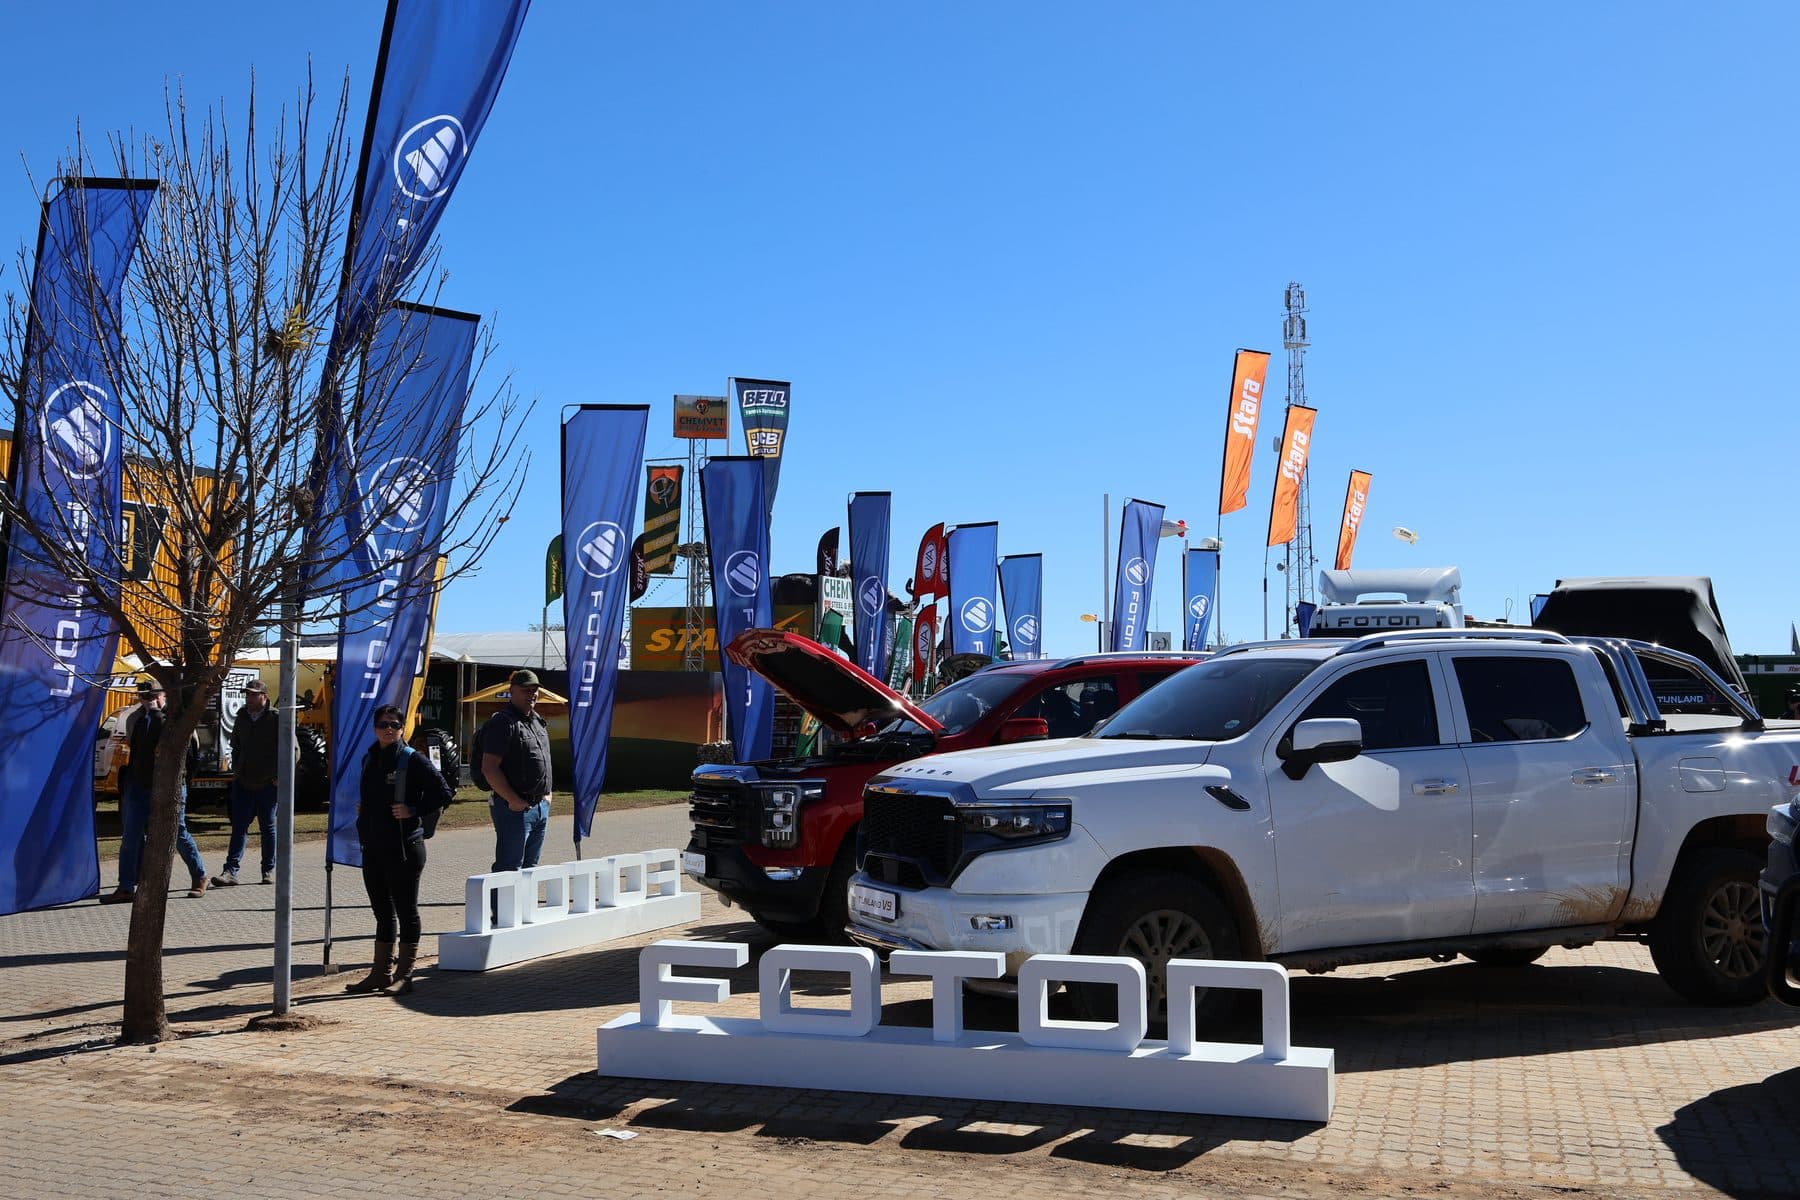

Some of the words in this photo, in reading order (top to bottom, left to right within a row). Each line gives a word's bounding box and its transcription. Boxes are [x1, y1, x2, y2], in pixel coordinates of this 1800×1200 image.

[742, 390, 786, 408] BELL
[1233, 378, 1260, 440] Stara
[751, 432, 779, 446] JCB
[1283, 429, 1308, 486] Stara
[1346, 490, 1365, 533] Stara
[1124, 591, 1139, 648] FOTON
[1337, 615, 1420, 627] FOTON
[578, 590, 603, 707] FOTON
[1657, 695, 1704, 704] TUNLAND
[882, 899, 893, 911] V9
[639, 940, 1290, 1061] FOTON
